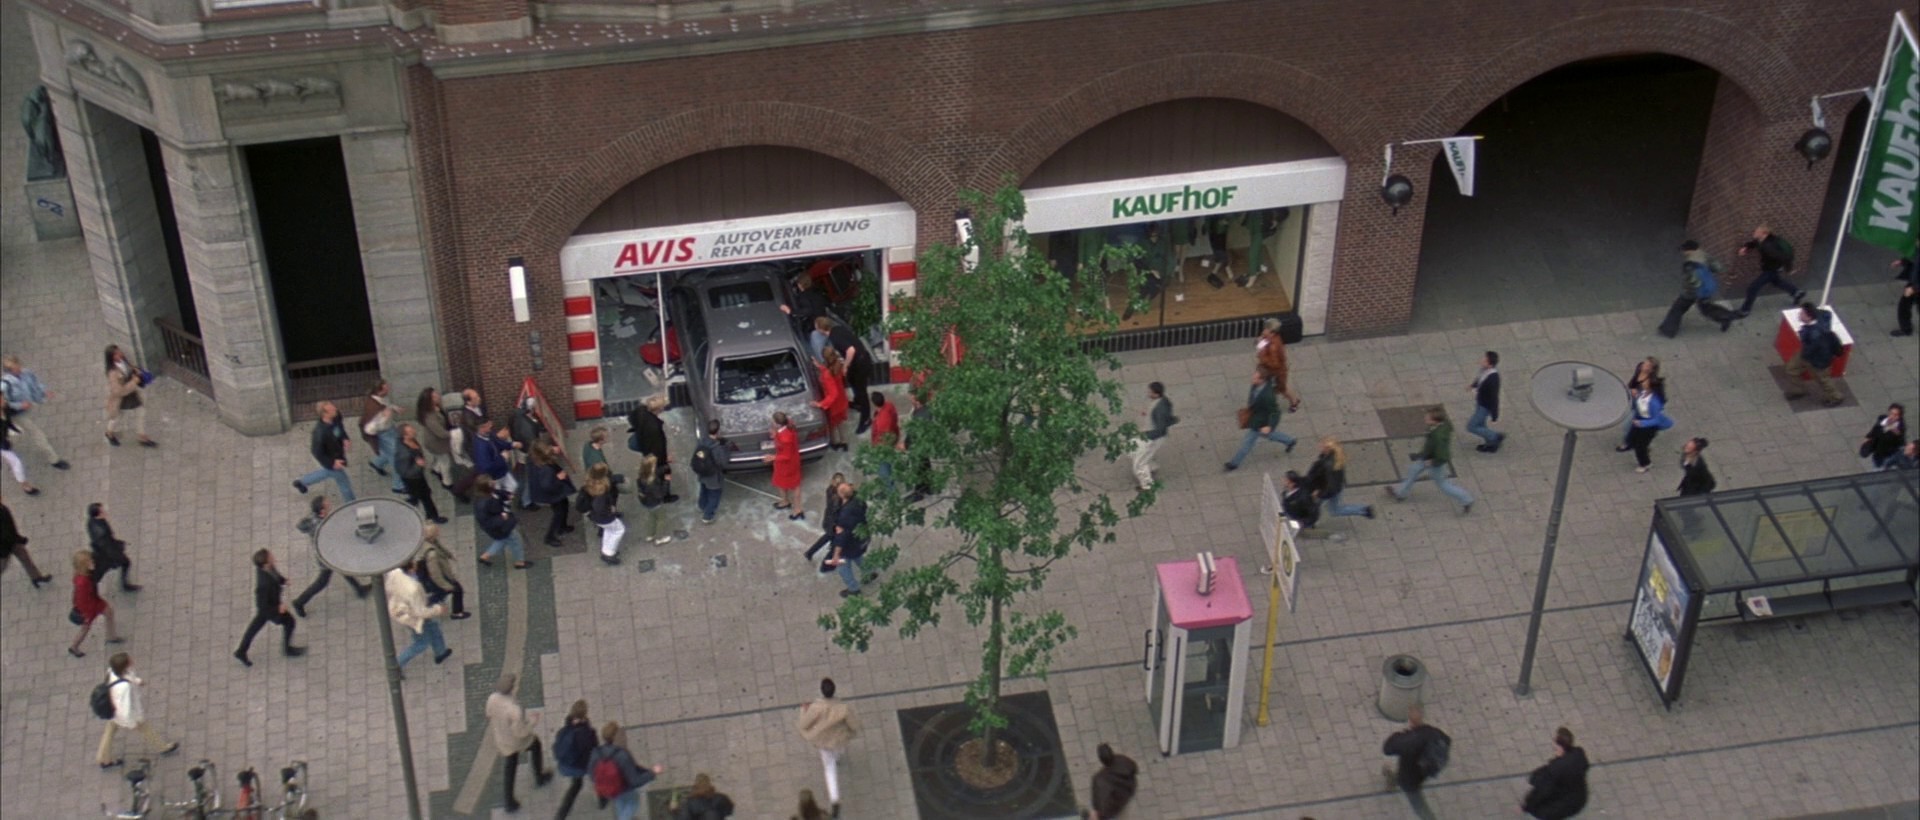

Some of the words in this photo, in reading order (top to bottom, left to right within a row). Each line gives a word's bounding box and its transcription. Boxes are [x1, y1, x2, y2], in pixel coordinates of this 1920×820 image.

[714, 218, 871, 246] AUTOVERMIETUNG
[614, 237, 697, 268] AVIS
[710, 244, 755, 259] RENT
[754, 243, 767, 254] A
[768, 239, 802, 252] CAR
